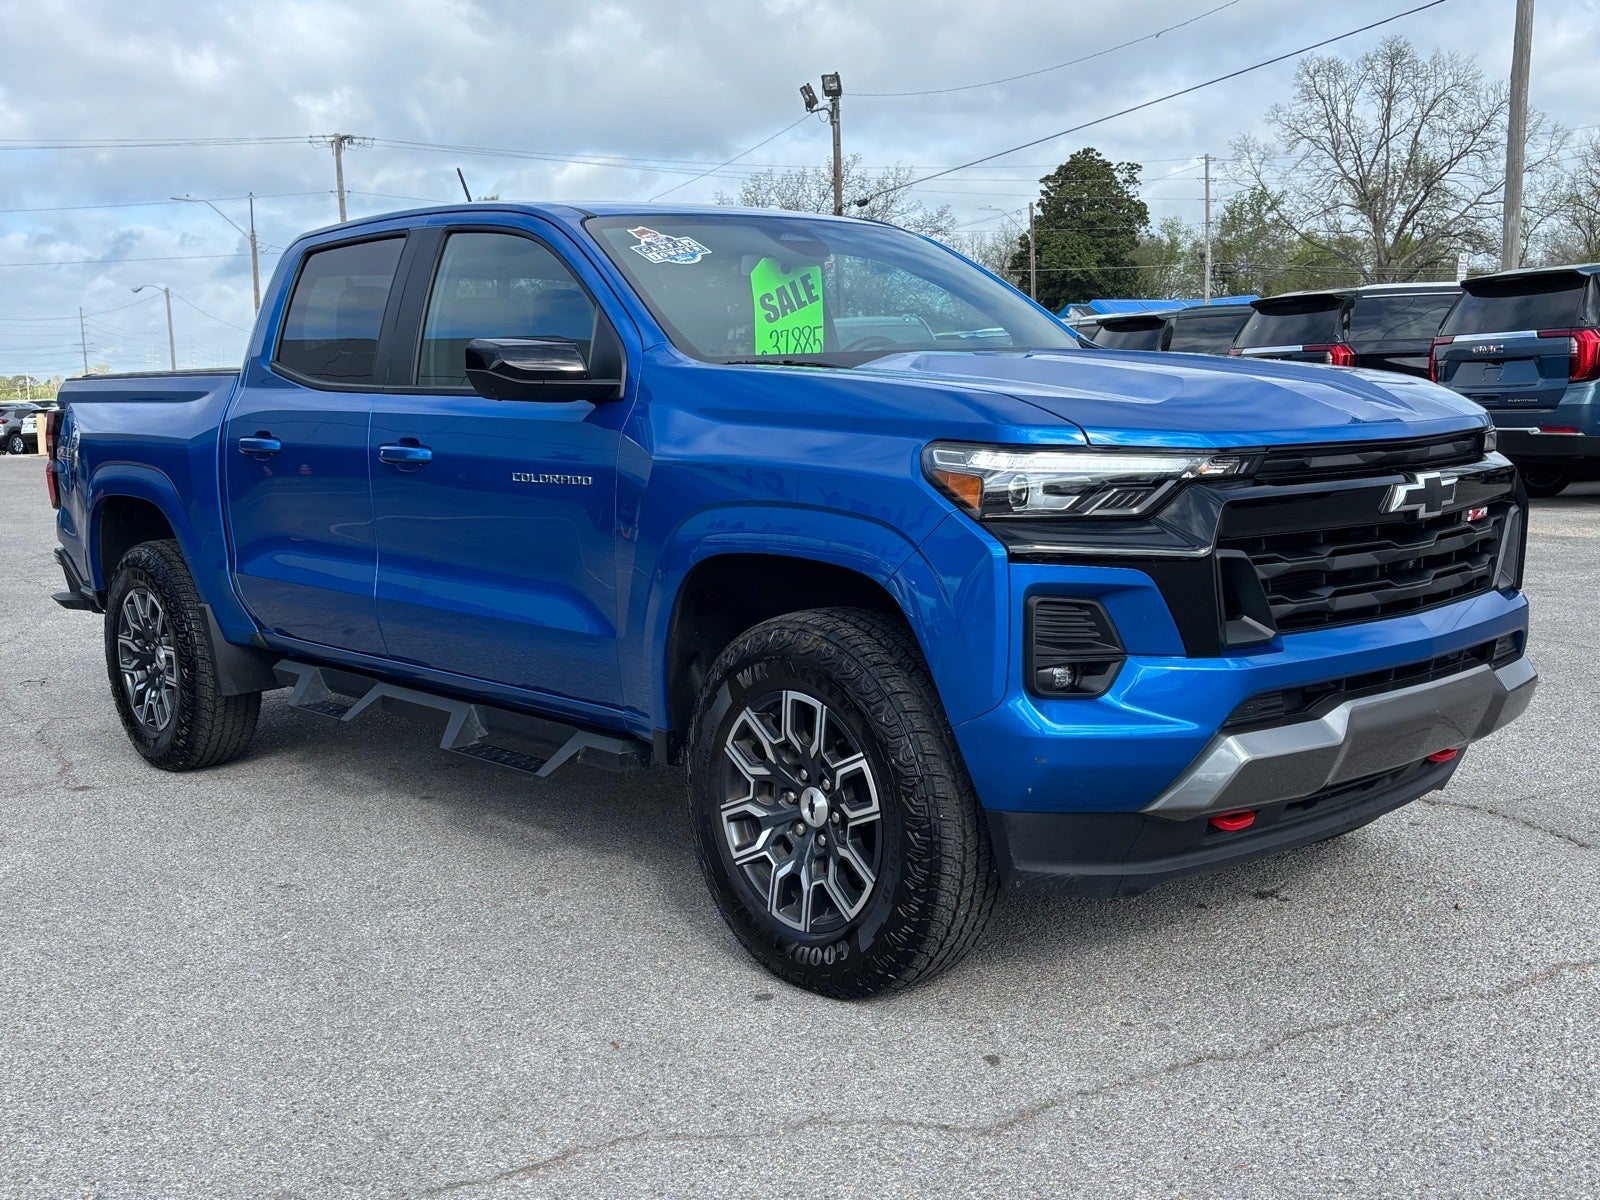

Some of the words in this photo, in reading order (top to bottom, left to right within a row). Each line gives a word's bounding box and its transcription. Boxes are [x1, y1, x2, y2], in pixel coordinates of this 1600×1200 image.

[759, 272, 820, 324] SALE
[761, 325, 823, 355] 37885
[1472, 344, 1504, 354] GMC
[512, 472, 592, 486] COLORADO
